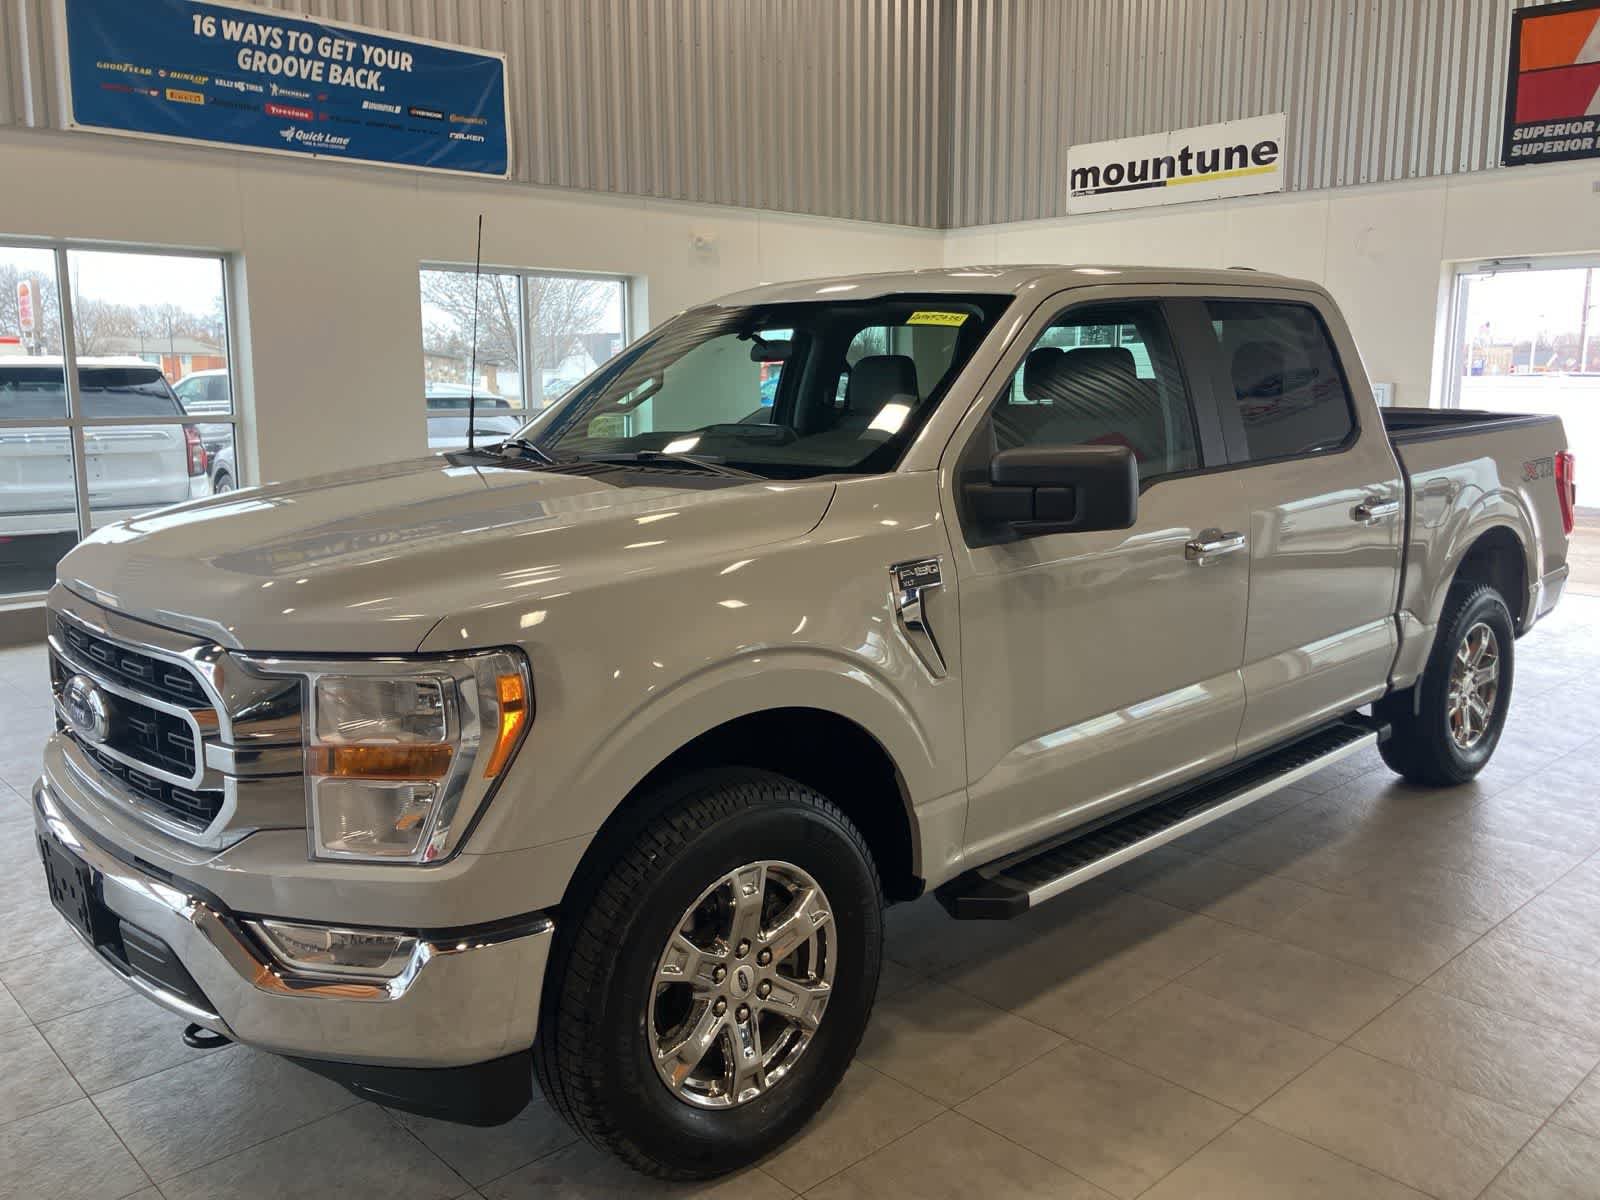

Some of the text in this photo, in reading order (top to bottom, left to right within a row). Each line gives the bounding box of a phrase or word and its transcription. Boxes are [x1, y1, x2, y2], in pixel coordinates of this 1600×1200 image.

[193, 14, 413, 72] 16 WAYS TO GET YOUR
[96, 61, 152, 76] GOODYEAR
[237, 47, 385, 92] GROOVE BACK.
[295, 129, 325, 143] Quick
[325, 133, 351, 145] Lane
[1512, 121, 1595, 141] SUPERIOR
[1511, 138, 1594, 157] SUPERIOR
[1071, 140, 1279, 190] mountune
